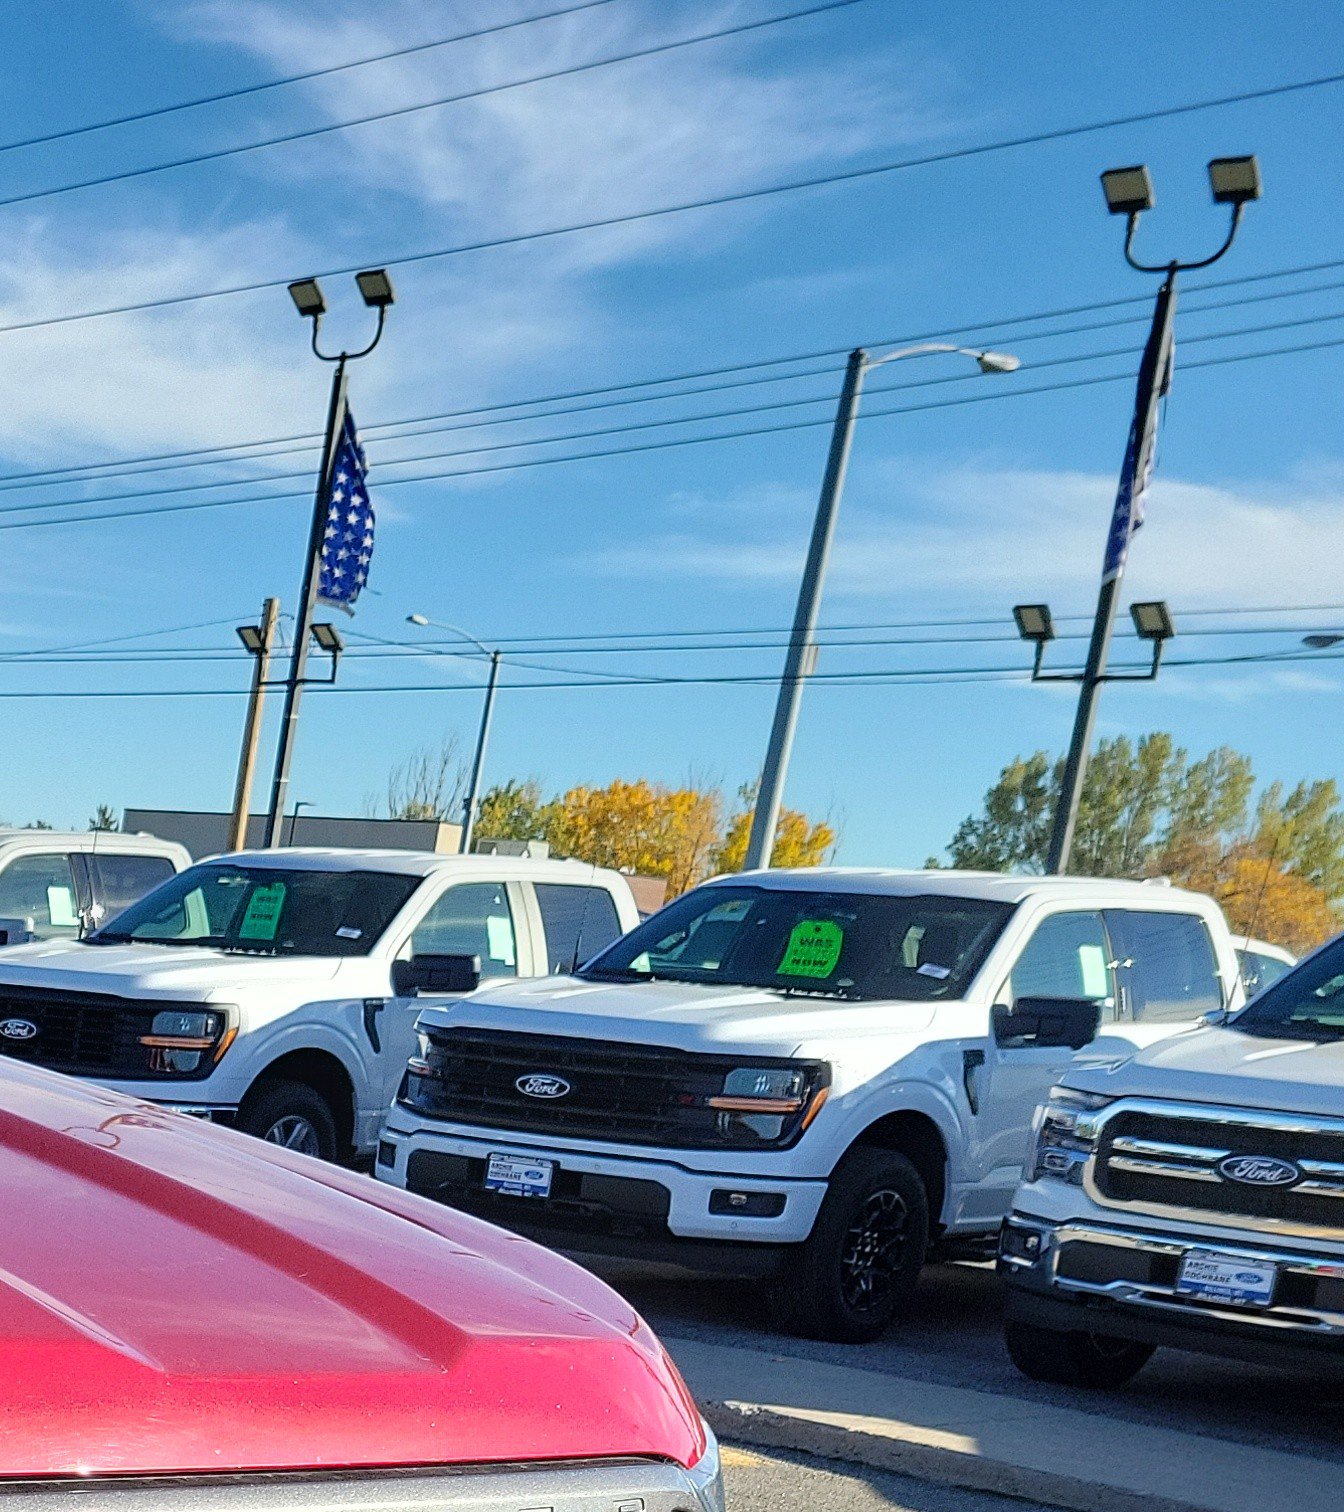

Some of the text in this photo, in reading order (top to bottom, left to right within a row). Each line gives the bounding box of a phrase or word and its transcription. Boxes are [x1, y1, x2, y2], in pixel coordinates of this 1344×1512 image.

[4, 1022, 29, 1036] Ford
[525, 1078, 559, 1095] Ford
[1234, 1160, 1283, 1182] Ford
[1187, 1260, 1219, 1273] ARCHIE
[1184, 1270, 1233, 1283] COCHRANE
